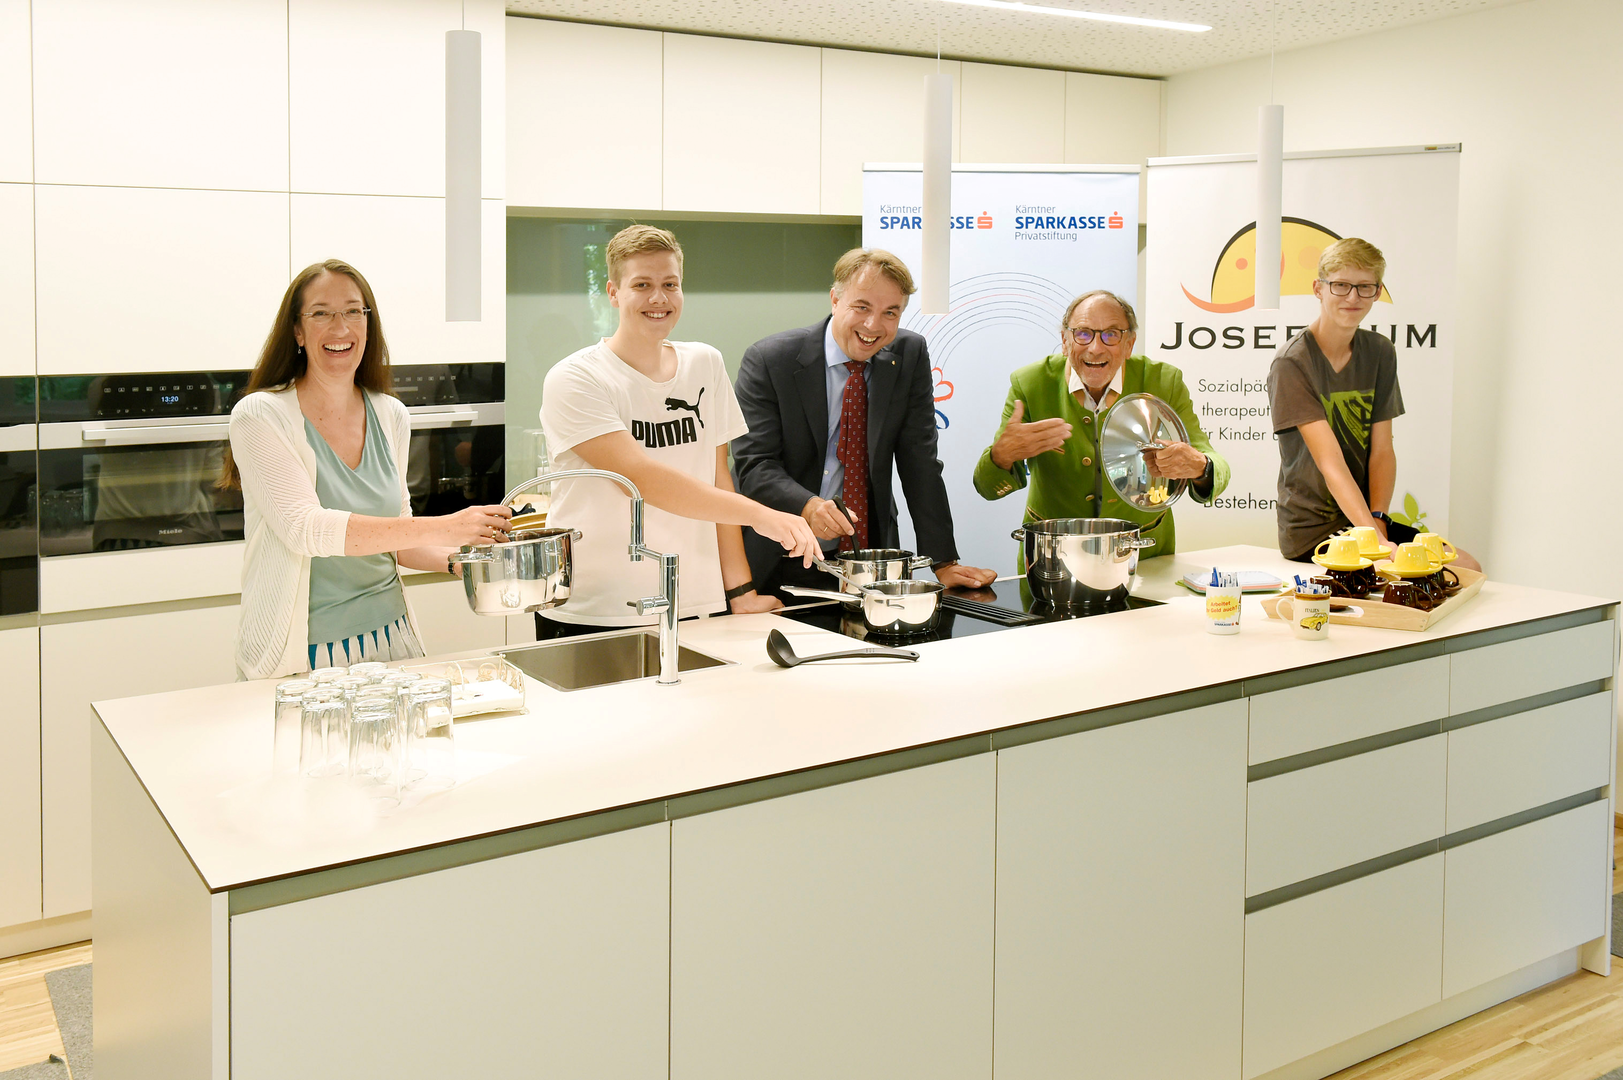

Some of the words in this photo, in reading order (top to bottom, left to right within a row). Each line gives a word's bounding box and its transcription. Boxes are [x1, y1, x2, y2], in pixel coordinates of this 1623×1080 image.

[880, 204, 922, 214] Kärntner
[1015, 204, 1056, 214] Kärntner
[1015, 216, 1105, 229] SPARKASSE
[1014, 231, 1078, 242] Privatstiftung
[631, 417, 697, 448] PUMA
[1219, 426, 1266, 441] Kinder
[1203, 492, 1278, 510] estehen
